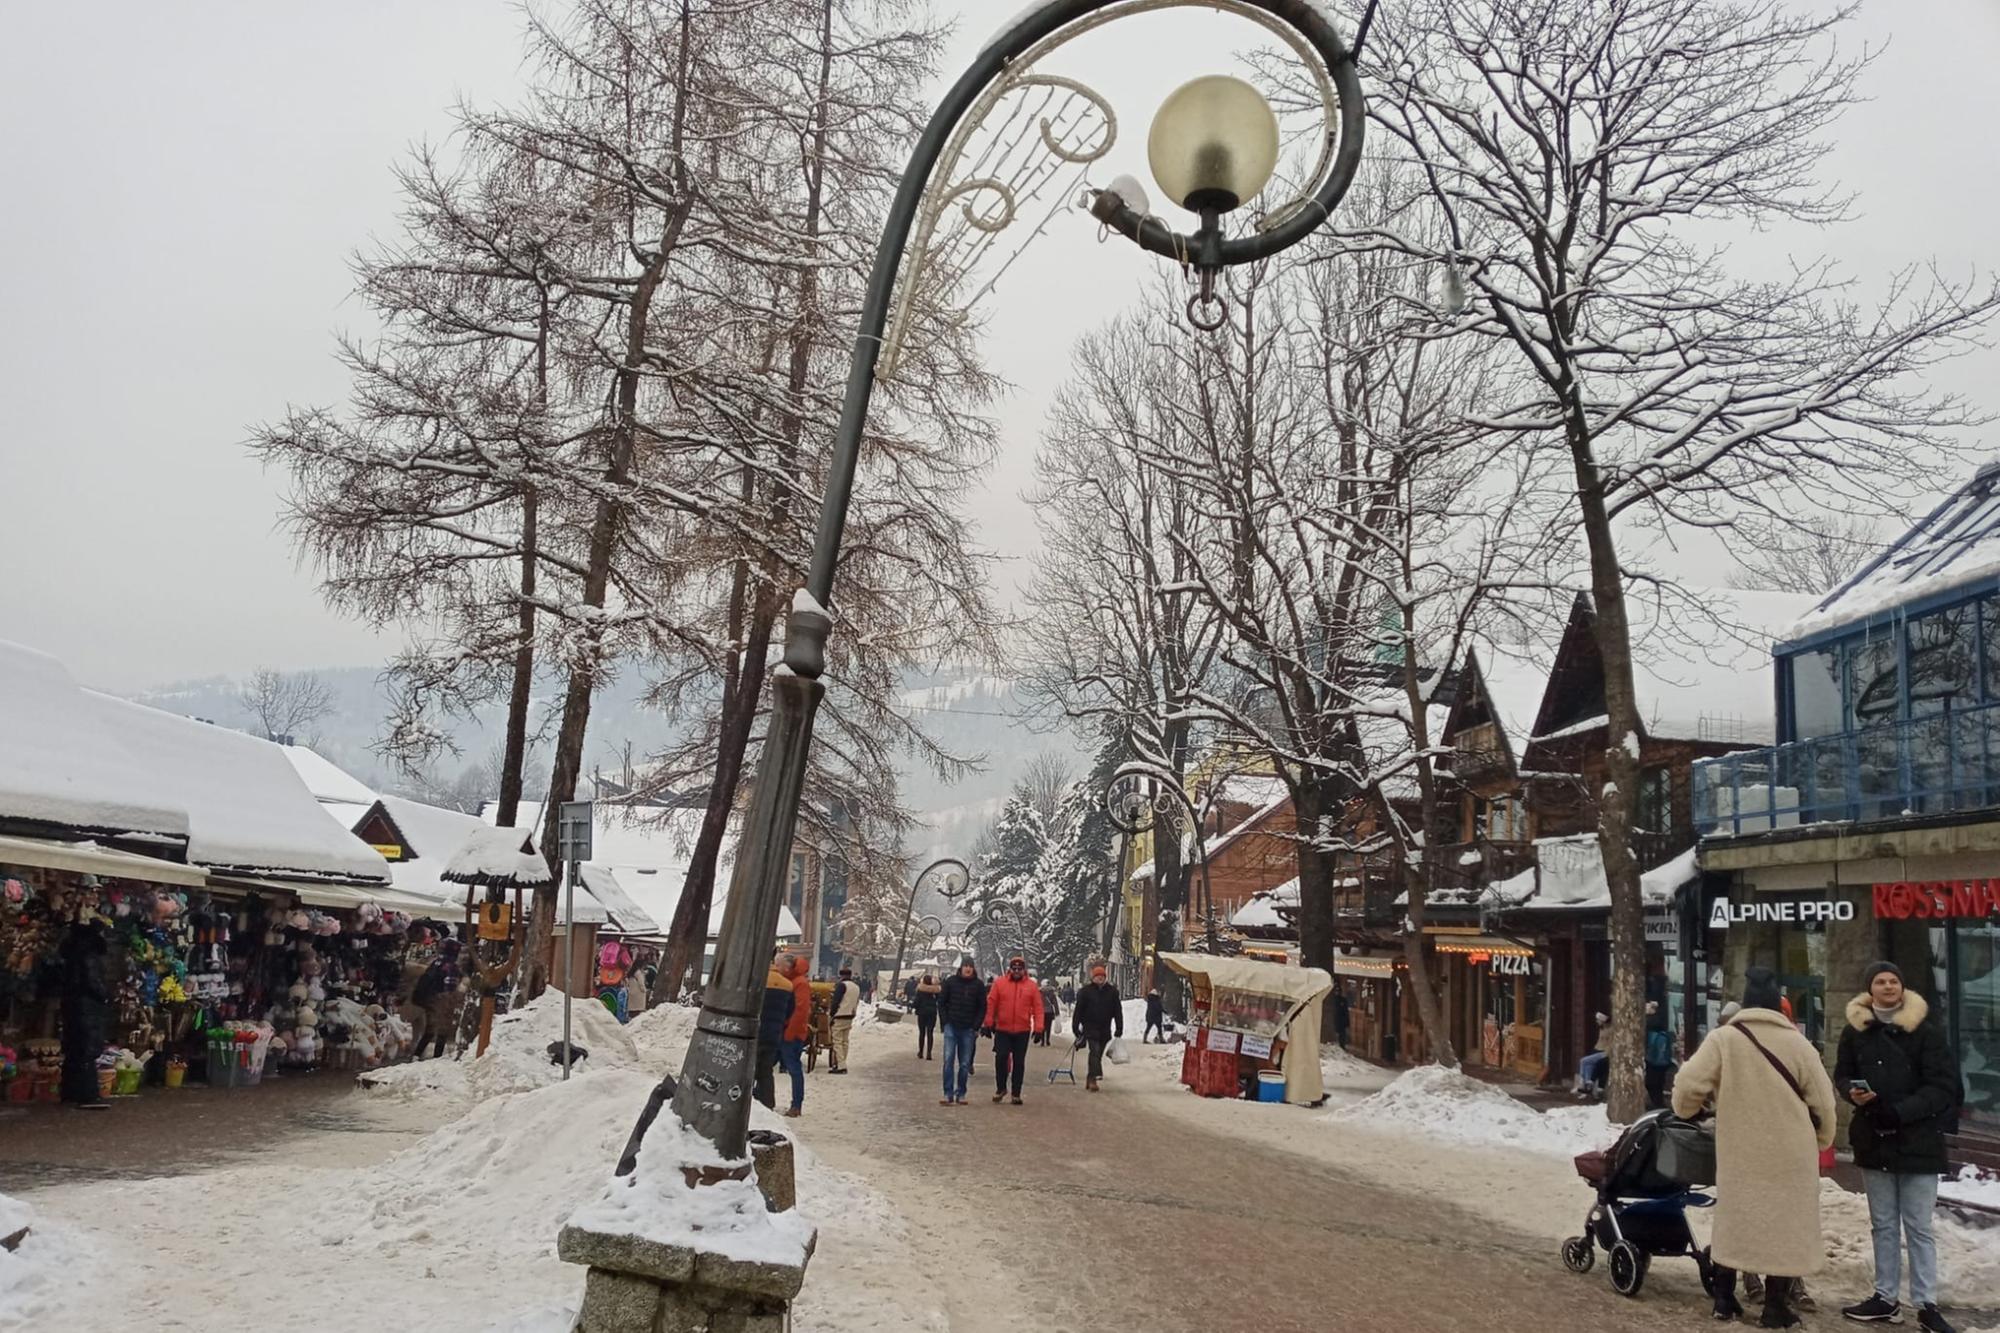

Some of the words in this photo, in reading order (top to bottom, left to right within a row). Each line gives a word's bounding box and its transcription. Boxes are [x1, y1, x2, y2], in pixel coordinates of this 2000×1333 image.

[1709, 897, 1795, 928] ALPINE
[1800, 901, 1854, 921] PRO
[1493, 954, 1530, 975] PIZZA
